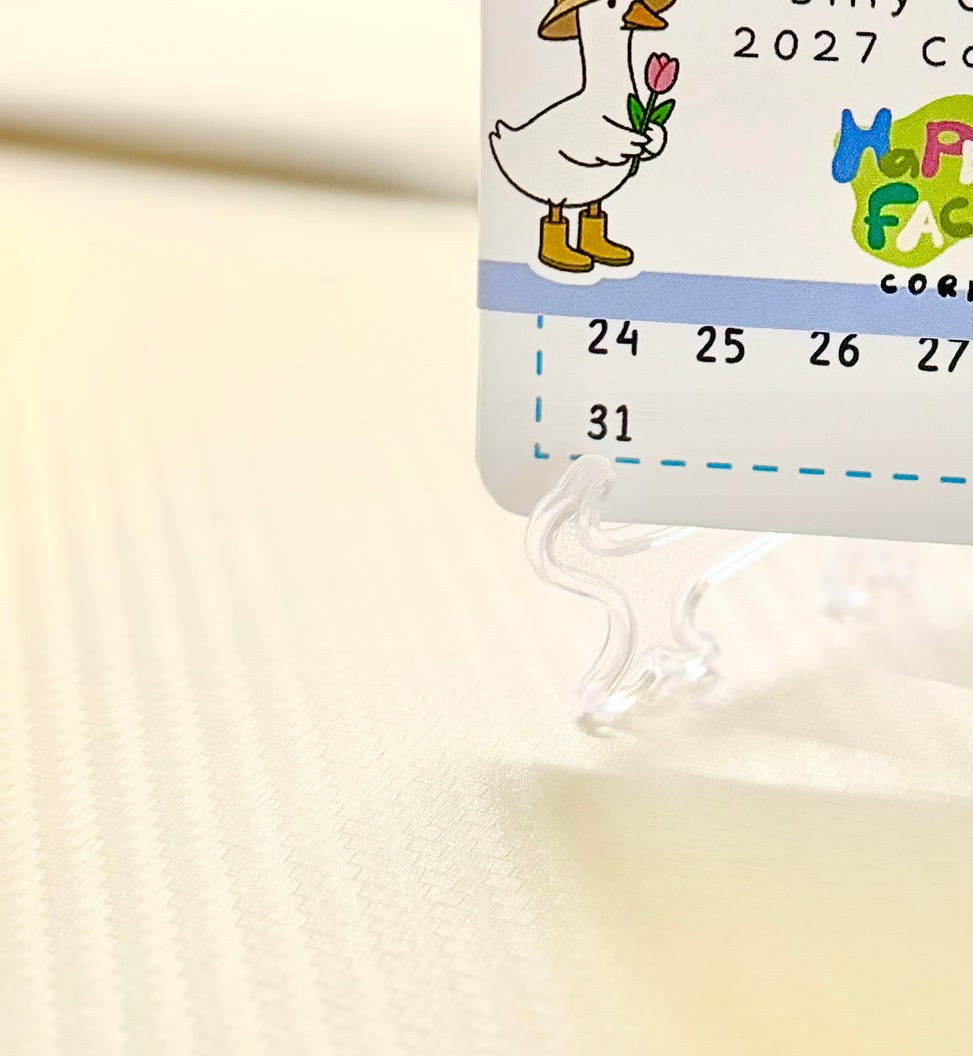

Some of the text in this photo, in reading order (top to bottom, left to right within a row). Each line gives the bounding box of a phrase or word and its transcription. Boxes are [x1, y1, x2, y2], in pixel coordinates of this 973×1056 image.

[733, 26, 877, 64] 2027
[588, 318, 639, 357] 24
[696, 325, 745, 364] 25
[809, 331, 860, 368] 26
[917, 337, 970, 373] 27
[587, 404, 632, 442] 31
